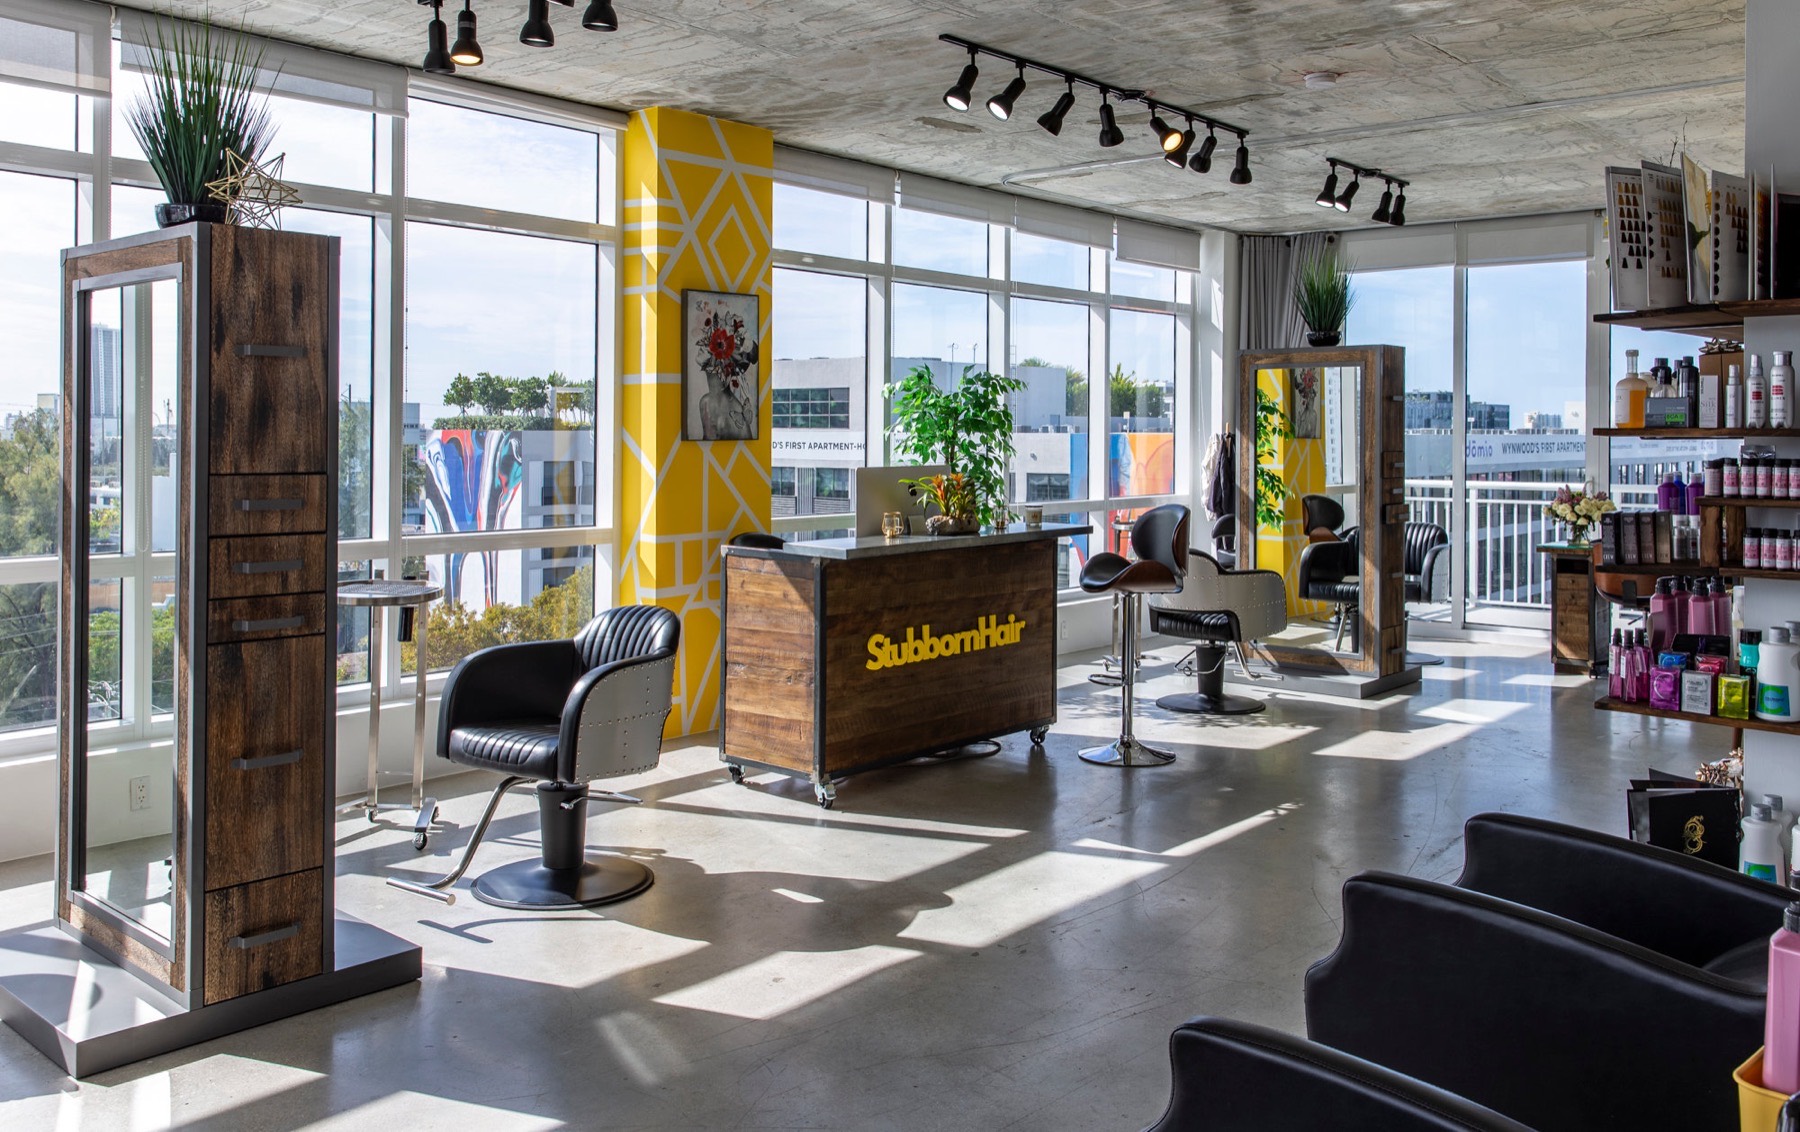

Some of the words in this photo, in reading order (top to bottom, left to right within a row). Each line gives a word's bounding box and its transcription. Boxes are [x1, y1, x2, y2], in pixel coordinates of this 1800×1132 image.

[785, 441, 806, 450] FIRST
[1501, 442, 1540, 454] WYNWOOD'S
[1541, 442, 1556, 453] FIRST
[865, 613, 1026, 671] StubbornHair
